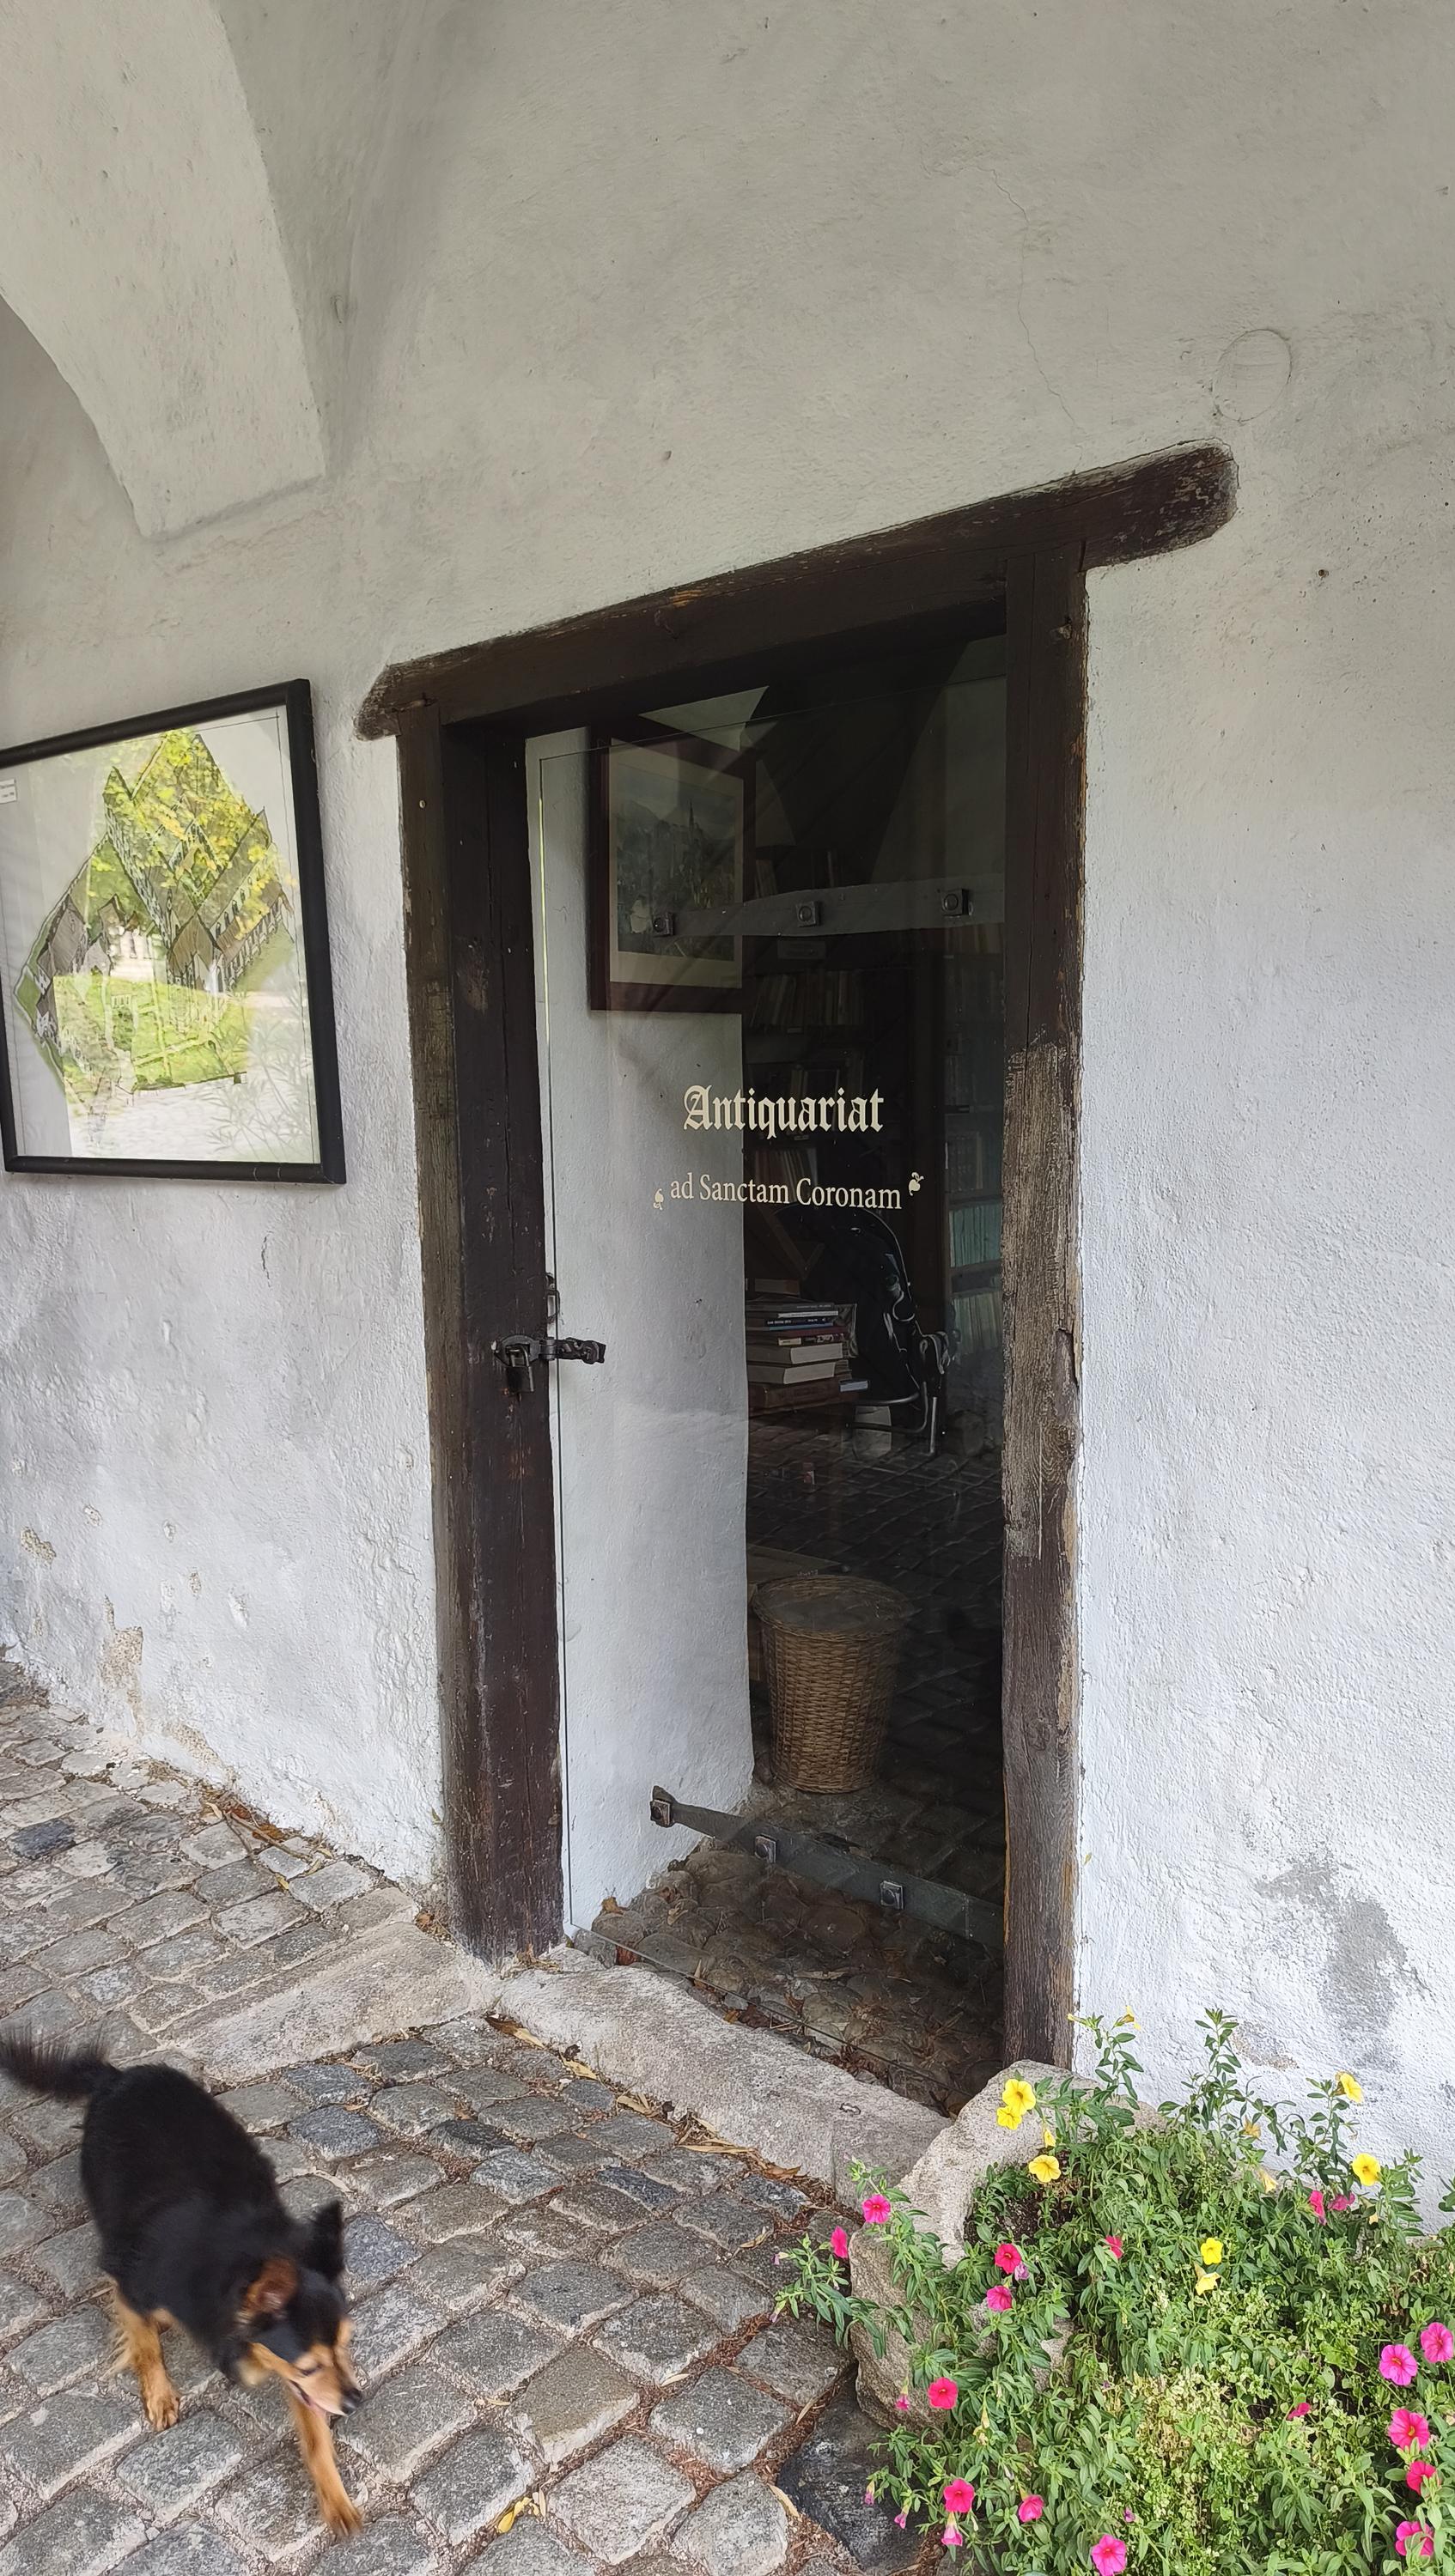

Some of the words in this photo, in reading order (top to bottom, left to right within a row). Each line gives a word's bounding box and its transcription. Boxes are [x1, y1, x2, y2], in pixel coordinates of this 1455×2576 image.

[683, 1084, 884, 1139] Antiquariat
[671, 1172, 693, 1200] ad
[699, 1174, 790, 1204] Sanctam
[796, 1178, 902, 1210] Coronam
